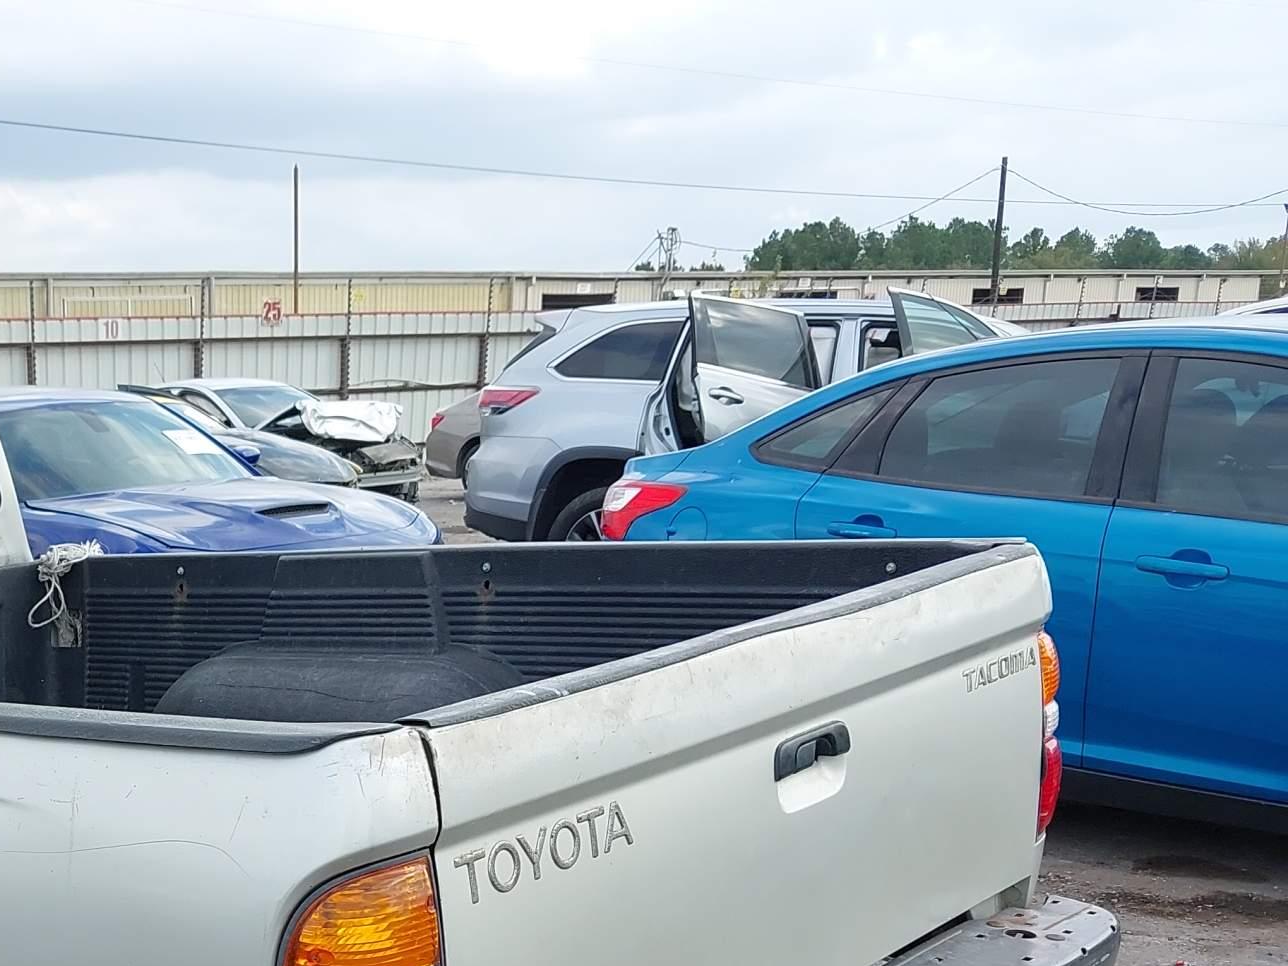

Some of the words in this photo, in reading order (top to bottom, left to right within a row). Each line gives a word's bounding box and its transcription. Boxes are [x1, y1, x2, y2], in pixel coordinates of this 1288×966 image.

[263, 301, 282, 322] 25
[103, 319, 119, 340] 10
[961, 646, 1037, 693] TACOMA
[453, 800, 634, 905] TOYOTA
